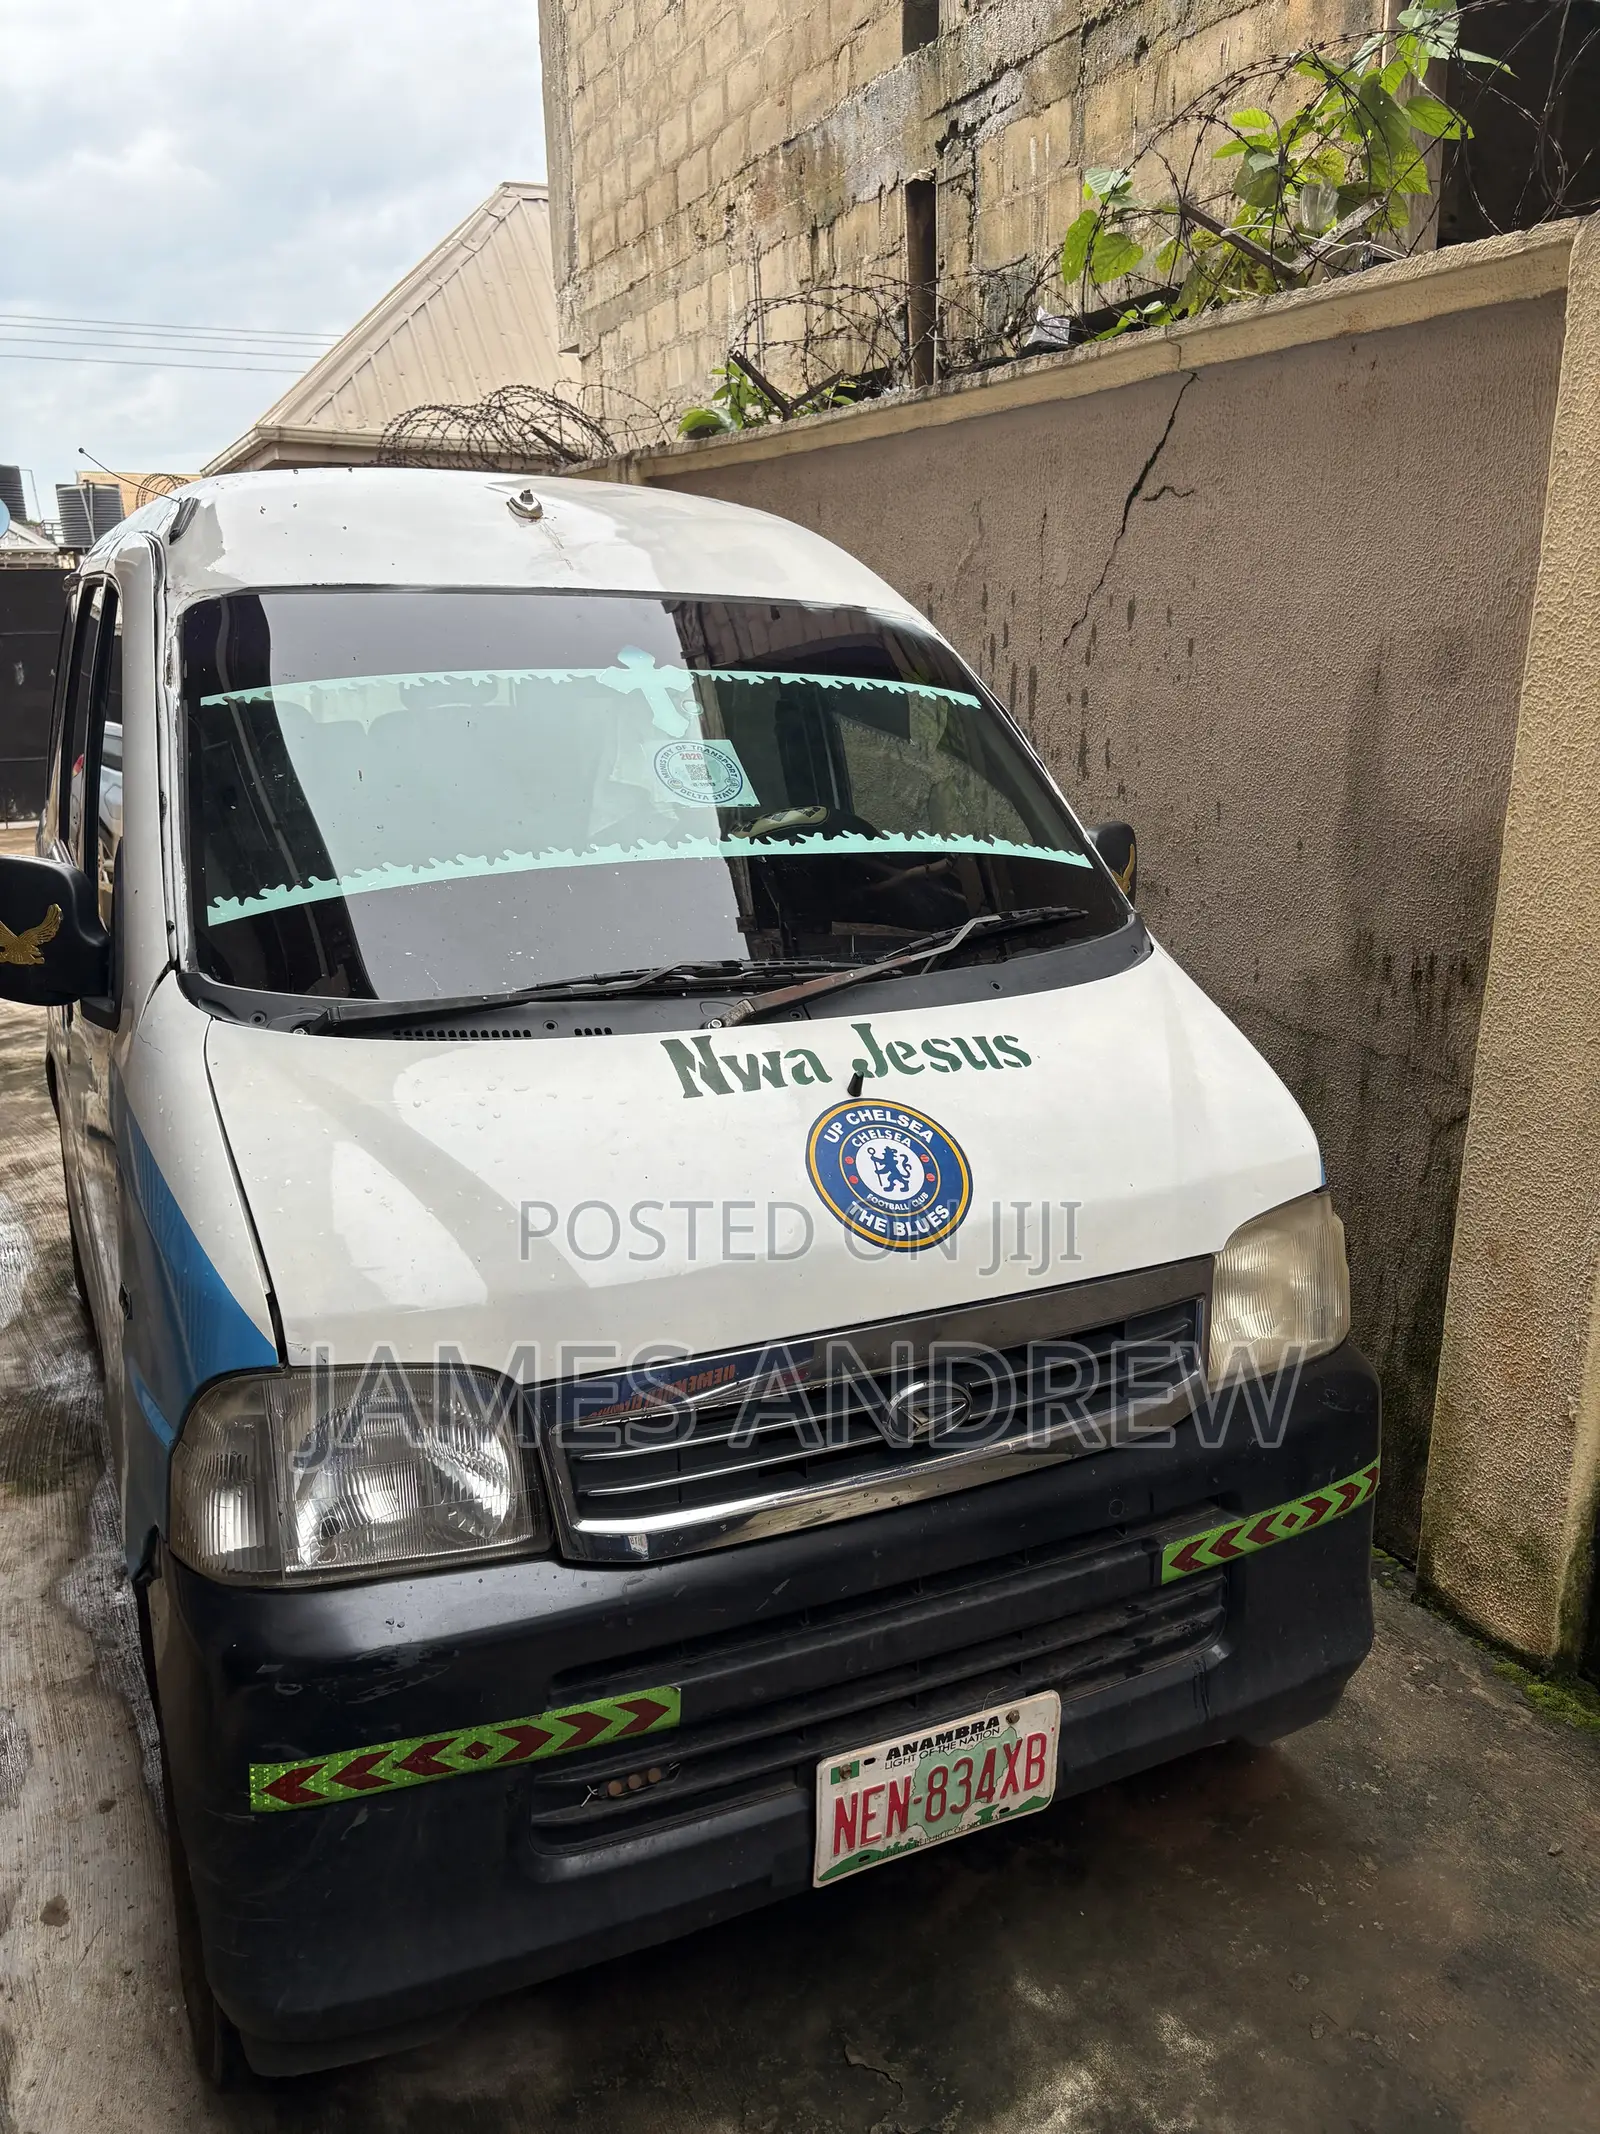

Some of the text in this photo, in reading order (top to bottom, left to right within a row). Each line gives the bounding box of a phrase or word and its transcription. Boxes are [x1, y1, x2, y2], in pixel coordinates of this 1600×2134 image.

[660, 748, 673, 779] MINISTRY
[691, 745, 738, 778] TRANSPORT
[680, 787, 735, 801] DELTA STATE
[660, 1022, 1033, 1099] Nwa Jesus
[823, 1109, 934, 1144] UP CHELSEA
[851, 1129, 912, 1147] CHELSEA
[849, 1201, 950, 1236] THE BLUES
[866, 1192, 929, 1210] FOOTBALL CLUB
[885, 1727, 1000, 1770] LIGHT OF THE NATION
[886, 1716, 1000, 1761] ANAMBRA
